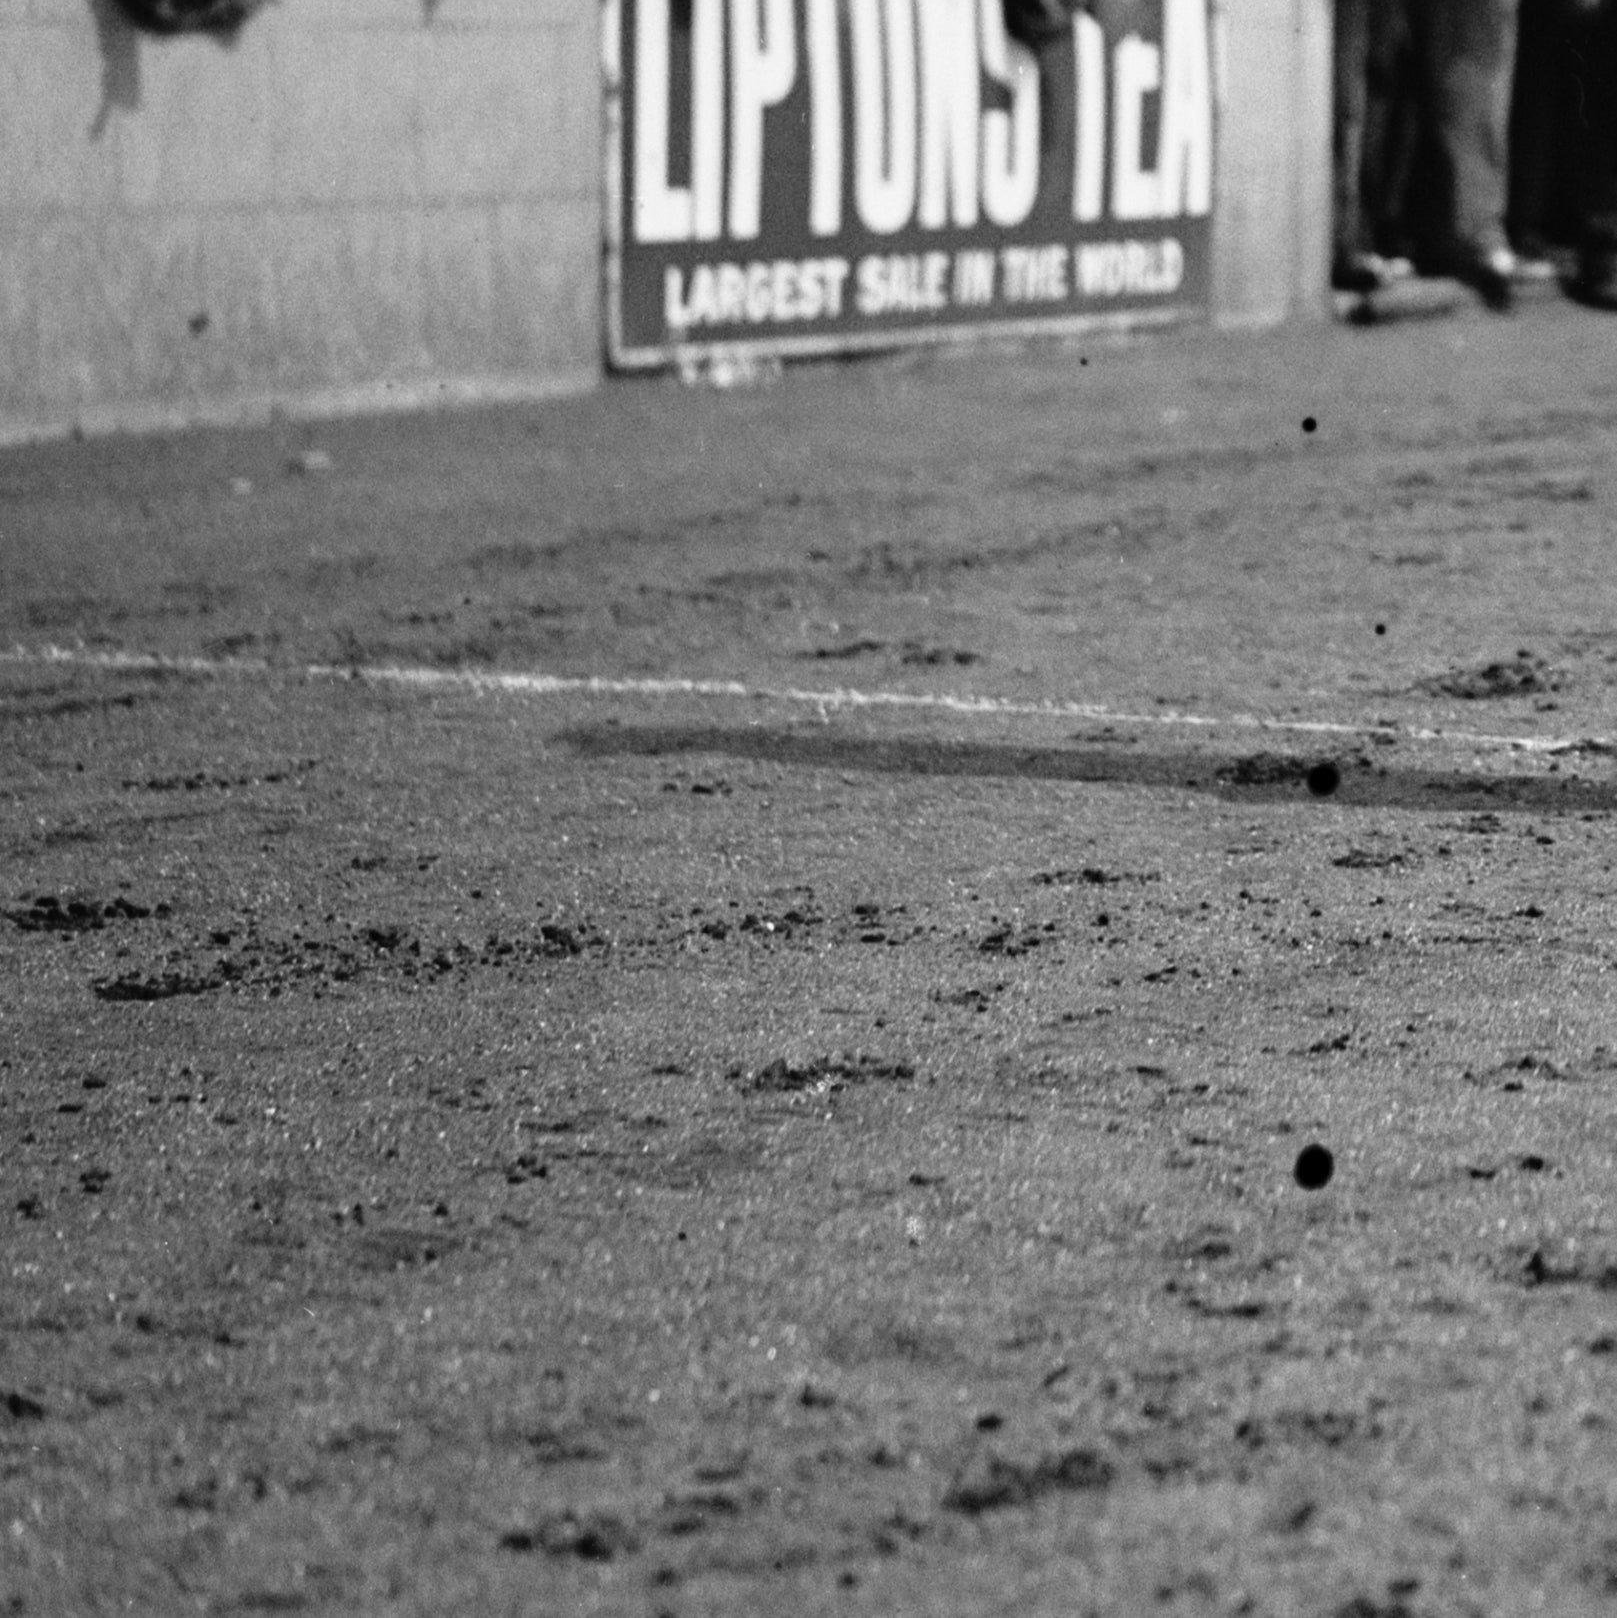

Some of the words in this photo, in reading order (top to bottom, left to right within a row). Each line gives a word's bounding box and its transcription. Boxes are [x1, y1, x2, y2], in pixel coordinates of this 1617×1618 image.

[664, 251, 850, 329] LARGEST
[857, 248, 949, 315] SALE
[953, 247, 997, 308] IN
[1000, 242, 1069, 303] THE
[1074, 236, 1185, 298] WORLD
